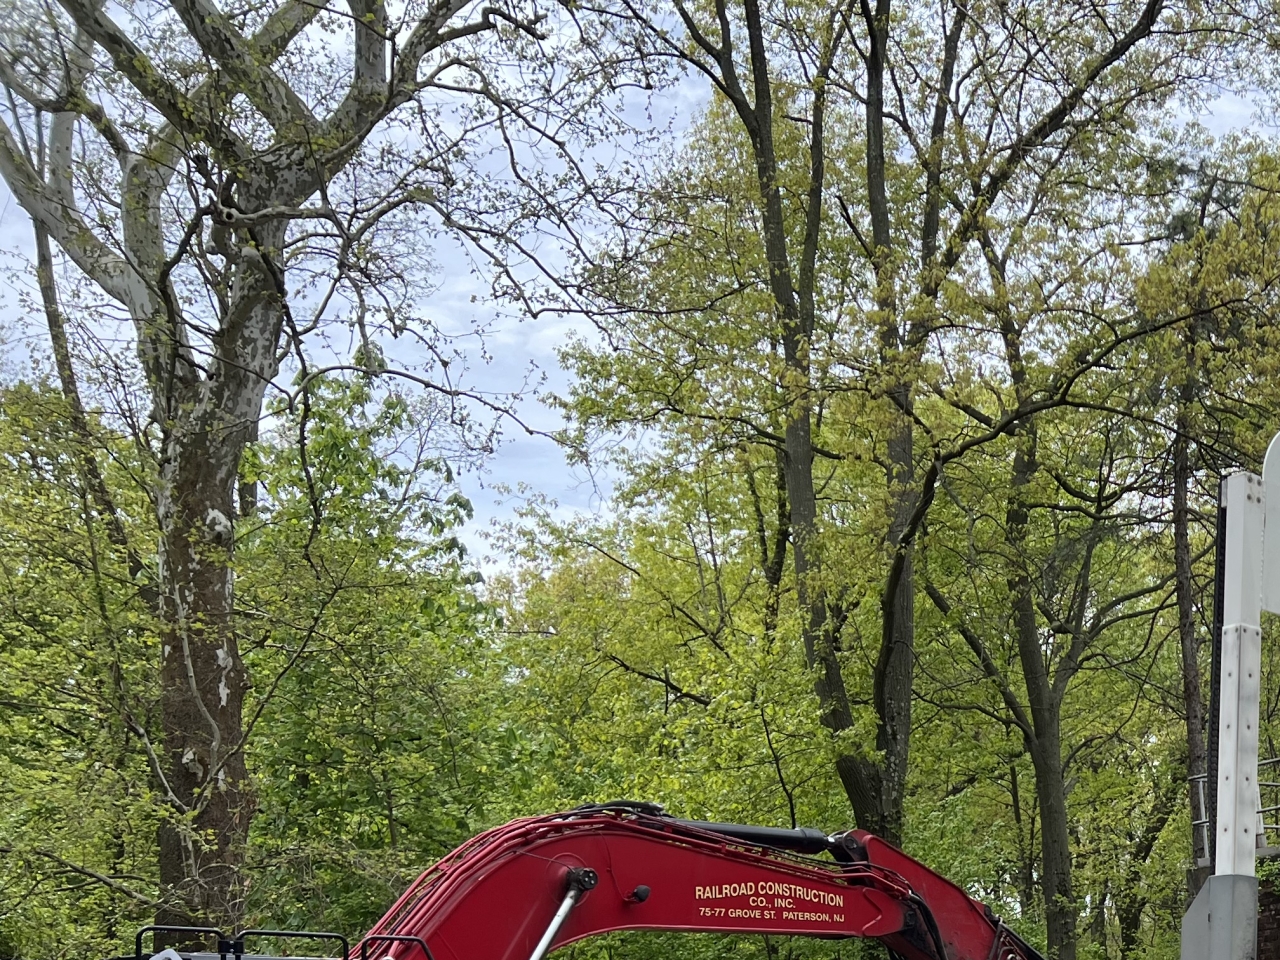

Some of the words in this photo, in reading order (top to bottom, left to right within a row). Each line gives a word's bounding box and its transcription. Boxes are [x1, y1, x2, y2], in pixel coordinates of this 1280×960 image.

[695, 882, 755, 899] RAILROAD
[758, 881, 844, 908] CONSTRUCTION
[749, 896, 772, 909] CO.,
[774, 898, 796, 909] INC.
[699, 907, 726, 917] 75-77
[728, 908, 762, 919] GROVE
[763, 910, 777, 920] ST.
[782, 911, 832, 923] PATERSON,
[833, 914, 845, 922] NJ
